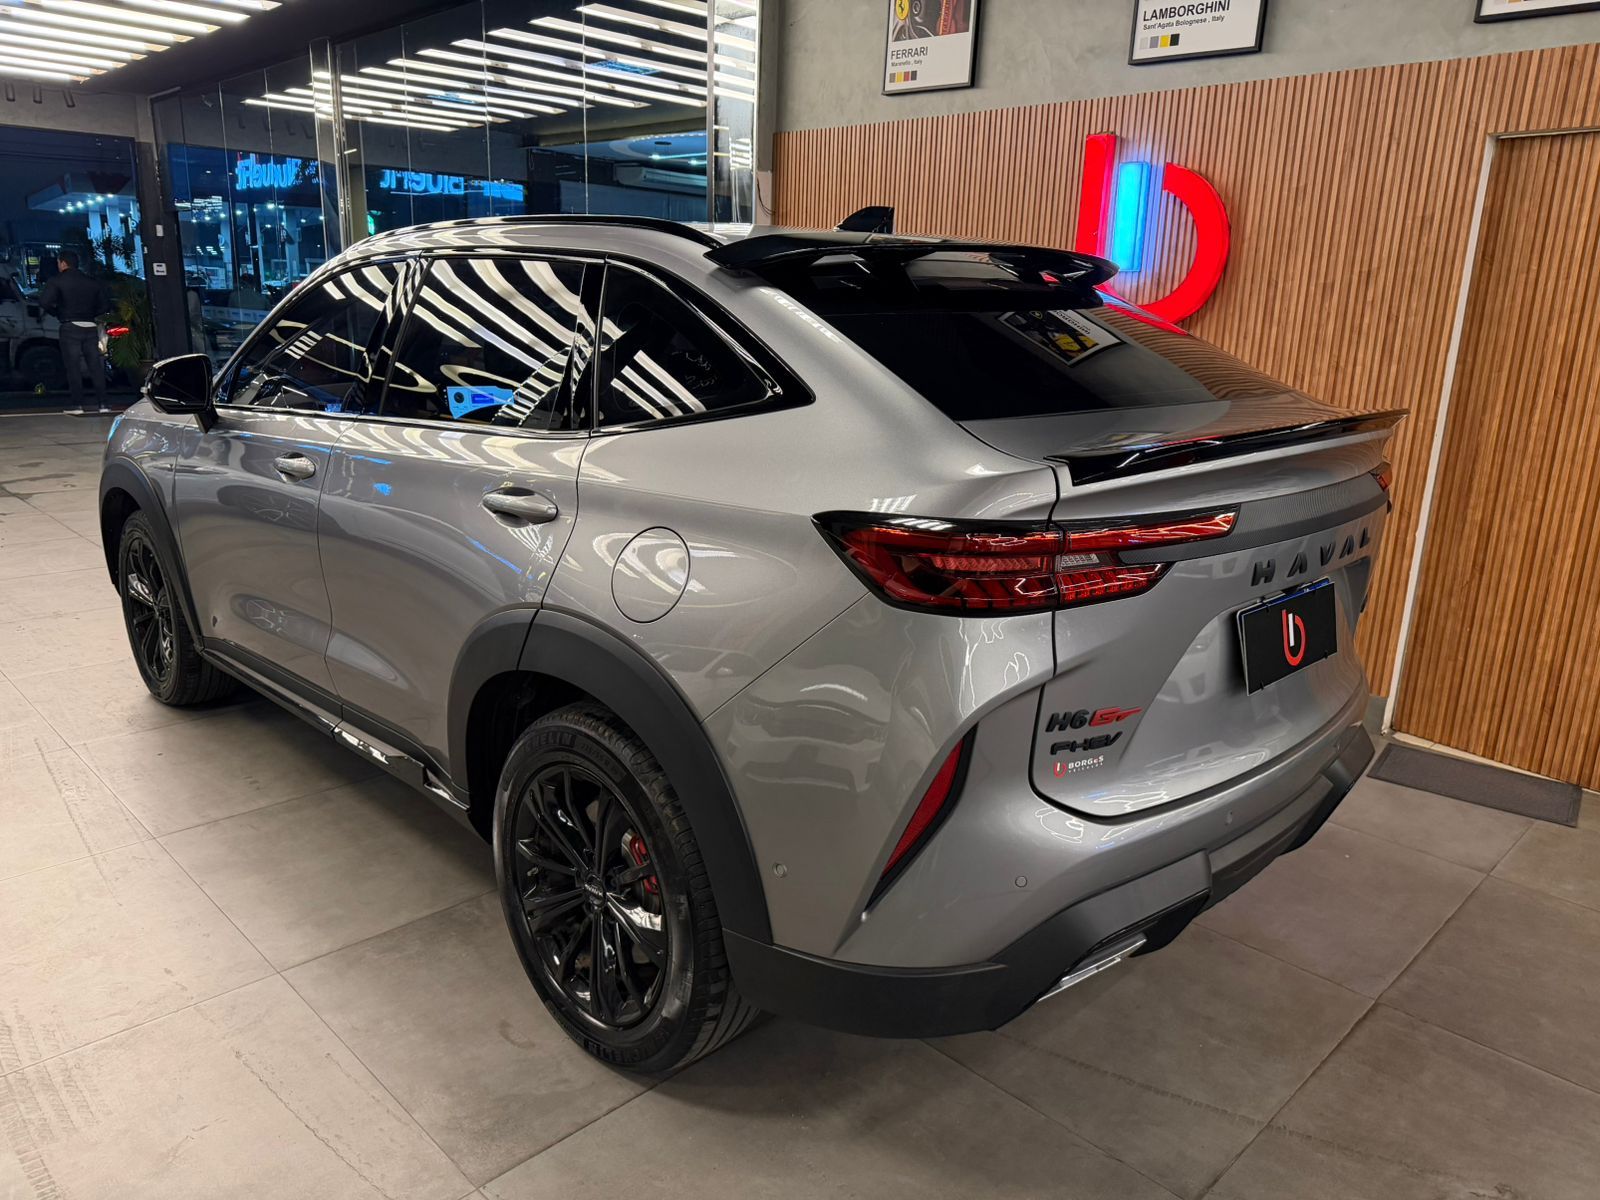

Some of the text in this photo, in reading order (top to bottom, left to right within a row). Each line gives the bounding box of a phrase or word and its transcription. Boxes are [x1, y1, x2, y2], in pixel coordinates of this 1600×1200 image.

[1143, 0, 1230, 21] LAMBORGHINI
[1211, 15, 1225, 23] Italy
[891, 46, 928, 60] FERRARI
[1251, 527, 1370, 587] HAVAL
[1045, 709, 1089, 732] H6
[1050, 731, 1123, 755] PHEV
